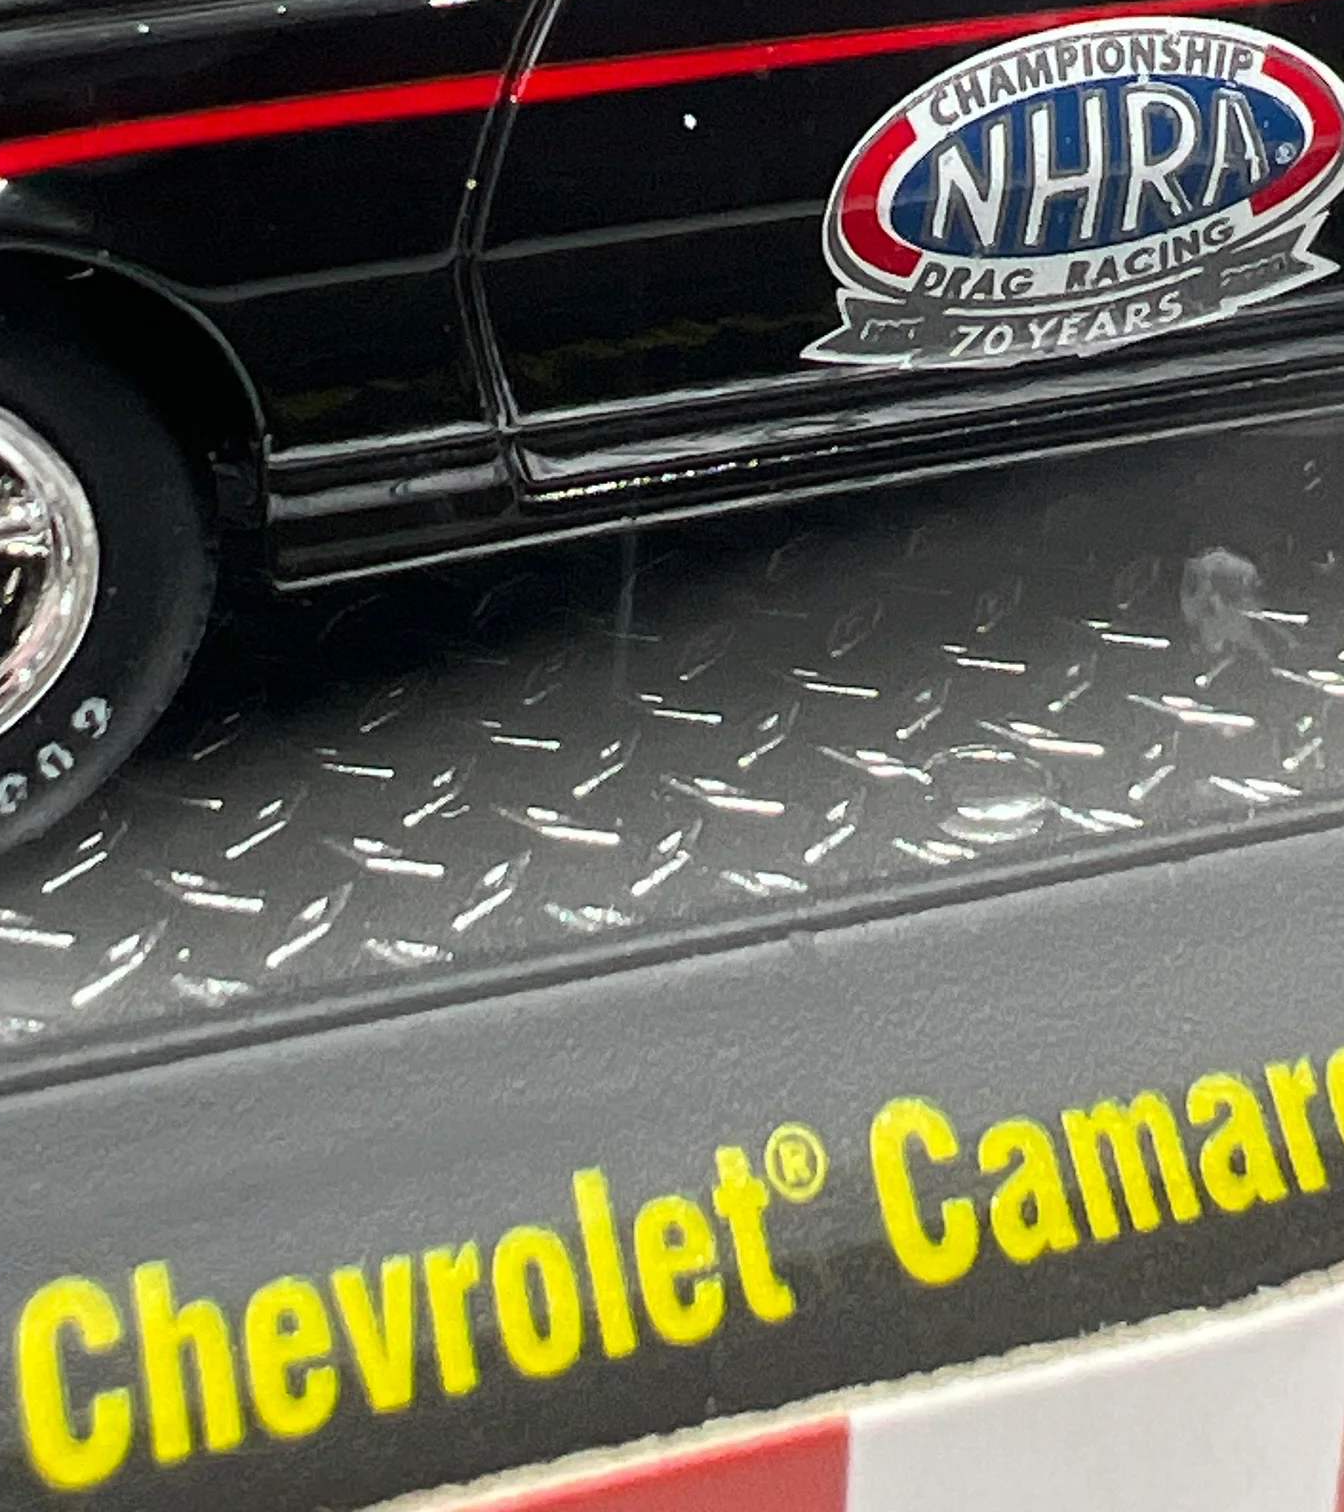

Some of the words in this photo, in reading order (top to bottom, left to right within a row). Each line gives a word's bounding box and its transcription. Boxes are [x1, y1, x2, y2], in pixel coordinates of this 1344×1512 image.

[929, 35, 1256, 126] CHAMPIONSHIP
[931, 83, 1272, 252] NHRA
[916, 261, 1035, 301] DRAG
[1065, 216, 1236, 291] RACING
[949, 324, 1014, 357] 70
[1028, 291, 1185, 351] YEARS
